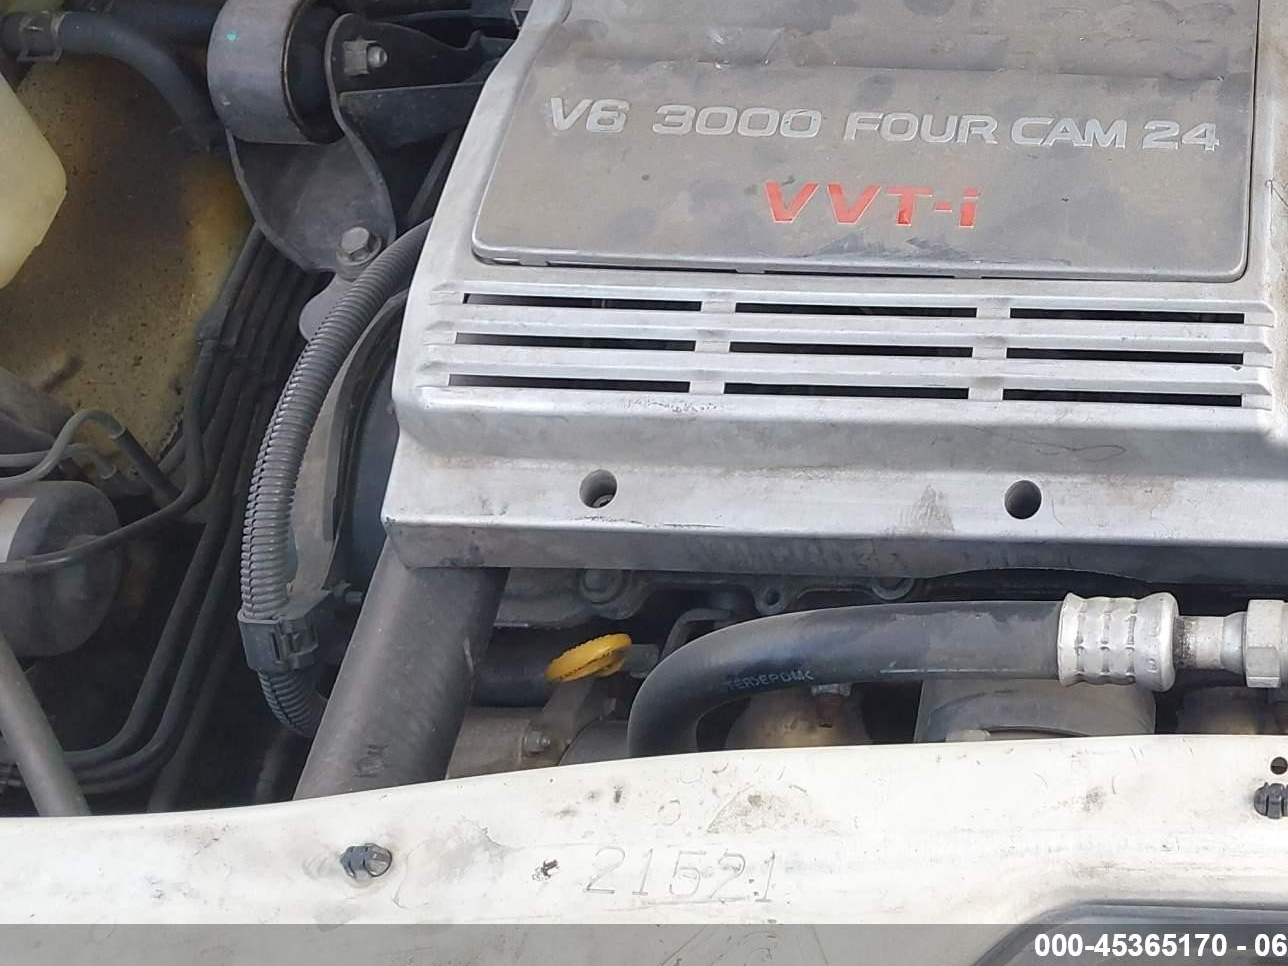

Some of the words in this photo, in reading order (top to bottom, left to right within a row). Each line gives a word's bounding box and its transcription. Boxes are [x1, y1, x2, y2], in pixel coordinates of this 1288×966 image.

[549, 96, 630, 134] V6
[652, 104, 823, 138] 3000
[844, 111, 999, 146] FOUR
[1011, 116, 1128, 150] CAM
[1141, 120, 1221, 153] 24
[763, 180, 981, 230] VVT-i
